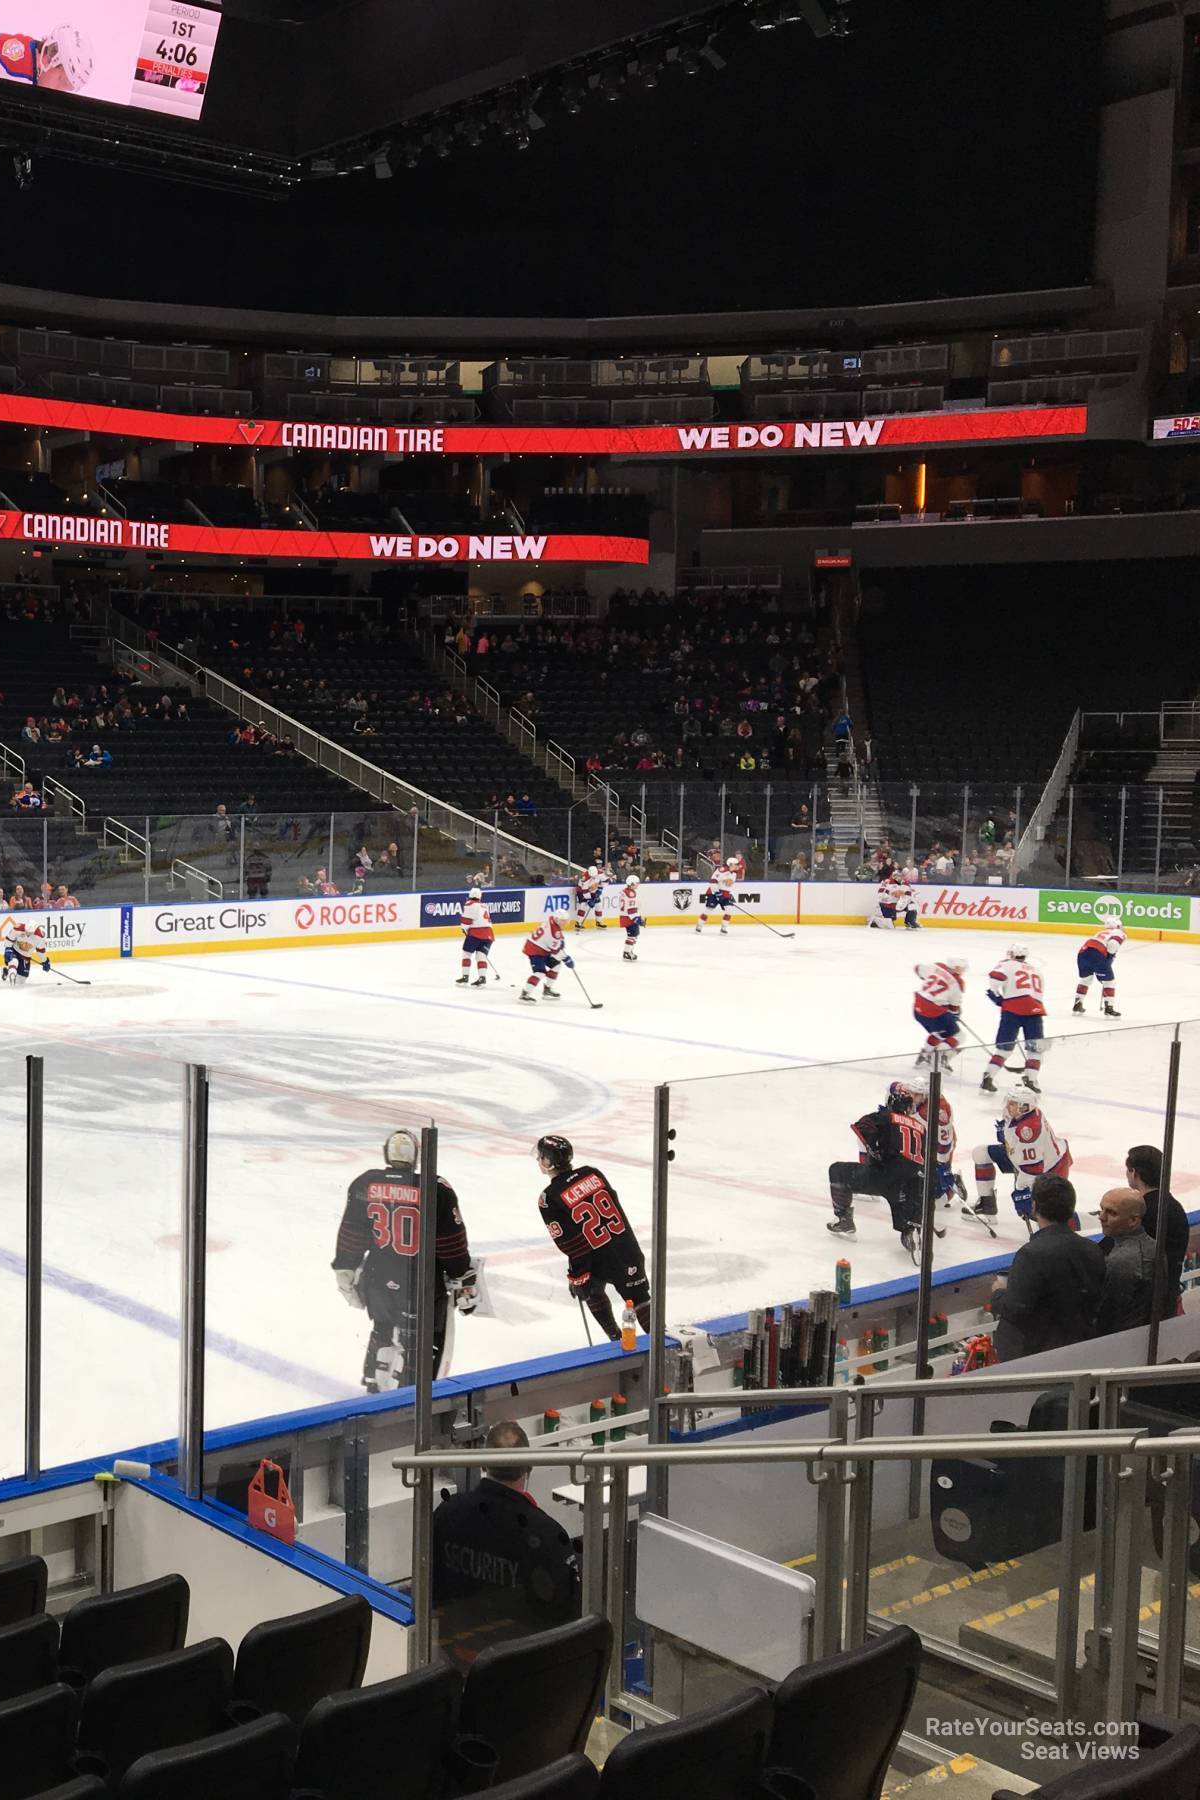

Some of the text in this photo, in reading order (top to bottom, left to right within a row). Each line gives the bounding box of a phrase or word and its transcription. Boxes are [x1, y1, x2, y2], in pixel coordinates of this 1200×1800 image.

[171, 4, 200, 19] PERIOD
[172, 20, 196, 38] 1ST
[156, 39, 198, 66] 4:06
[152, 62, 193, 79] PENALTIES
[282, 423, 444, 452] CANADIAN TIRE
[678, 420, 885, 450] WE DO NEW
[23, 513, 169, 548] CANADIAN TIRE
[369, 535, 548, 560] WE DO NEW
[320, 903, 398, 926] ROGERS
[435, 902, 463, 916] AMA
[502, 900, 521, 912] SAVES
[543, 895, 570, 912] ATB
[933, 889, 1029, 920] Hortons
[1047, 900, 1182, 919] save on foods
[38, 916, 87, 943] shley
[155, 909, 267, 934] Great Clips
[1015, 970, 1043, 994] 20
[900, 1125, 925, 1166] 11
[1022, 1148, 1037, 1160] 10
[369, 1185, 418, 1202] SALMOND
[367, 1203, 421, 1257] 30
[571, 1189, 626, 1250] 29
[444, 1541, 520, 1589] SECURITY
